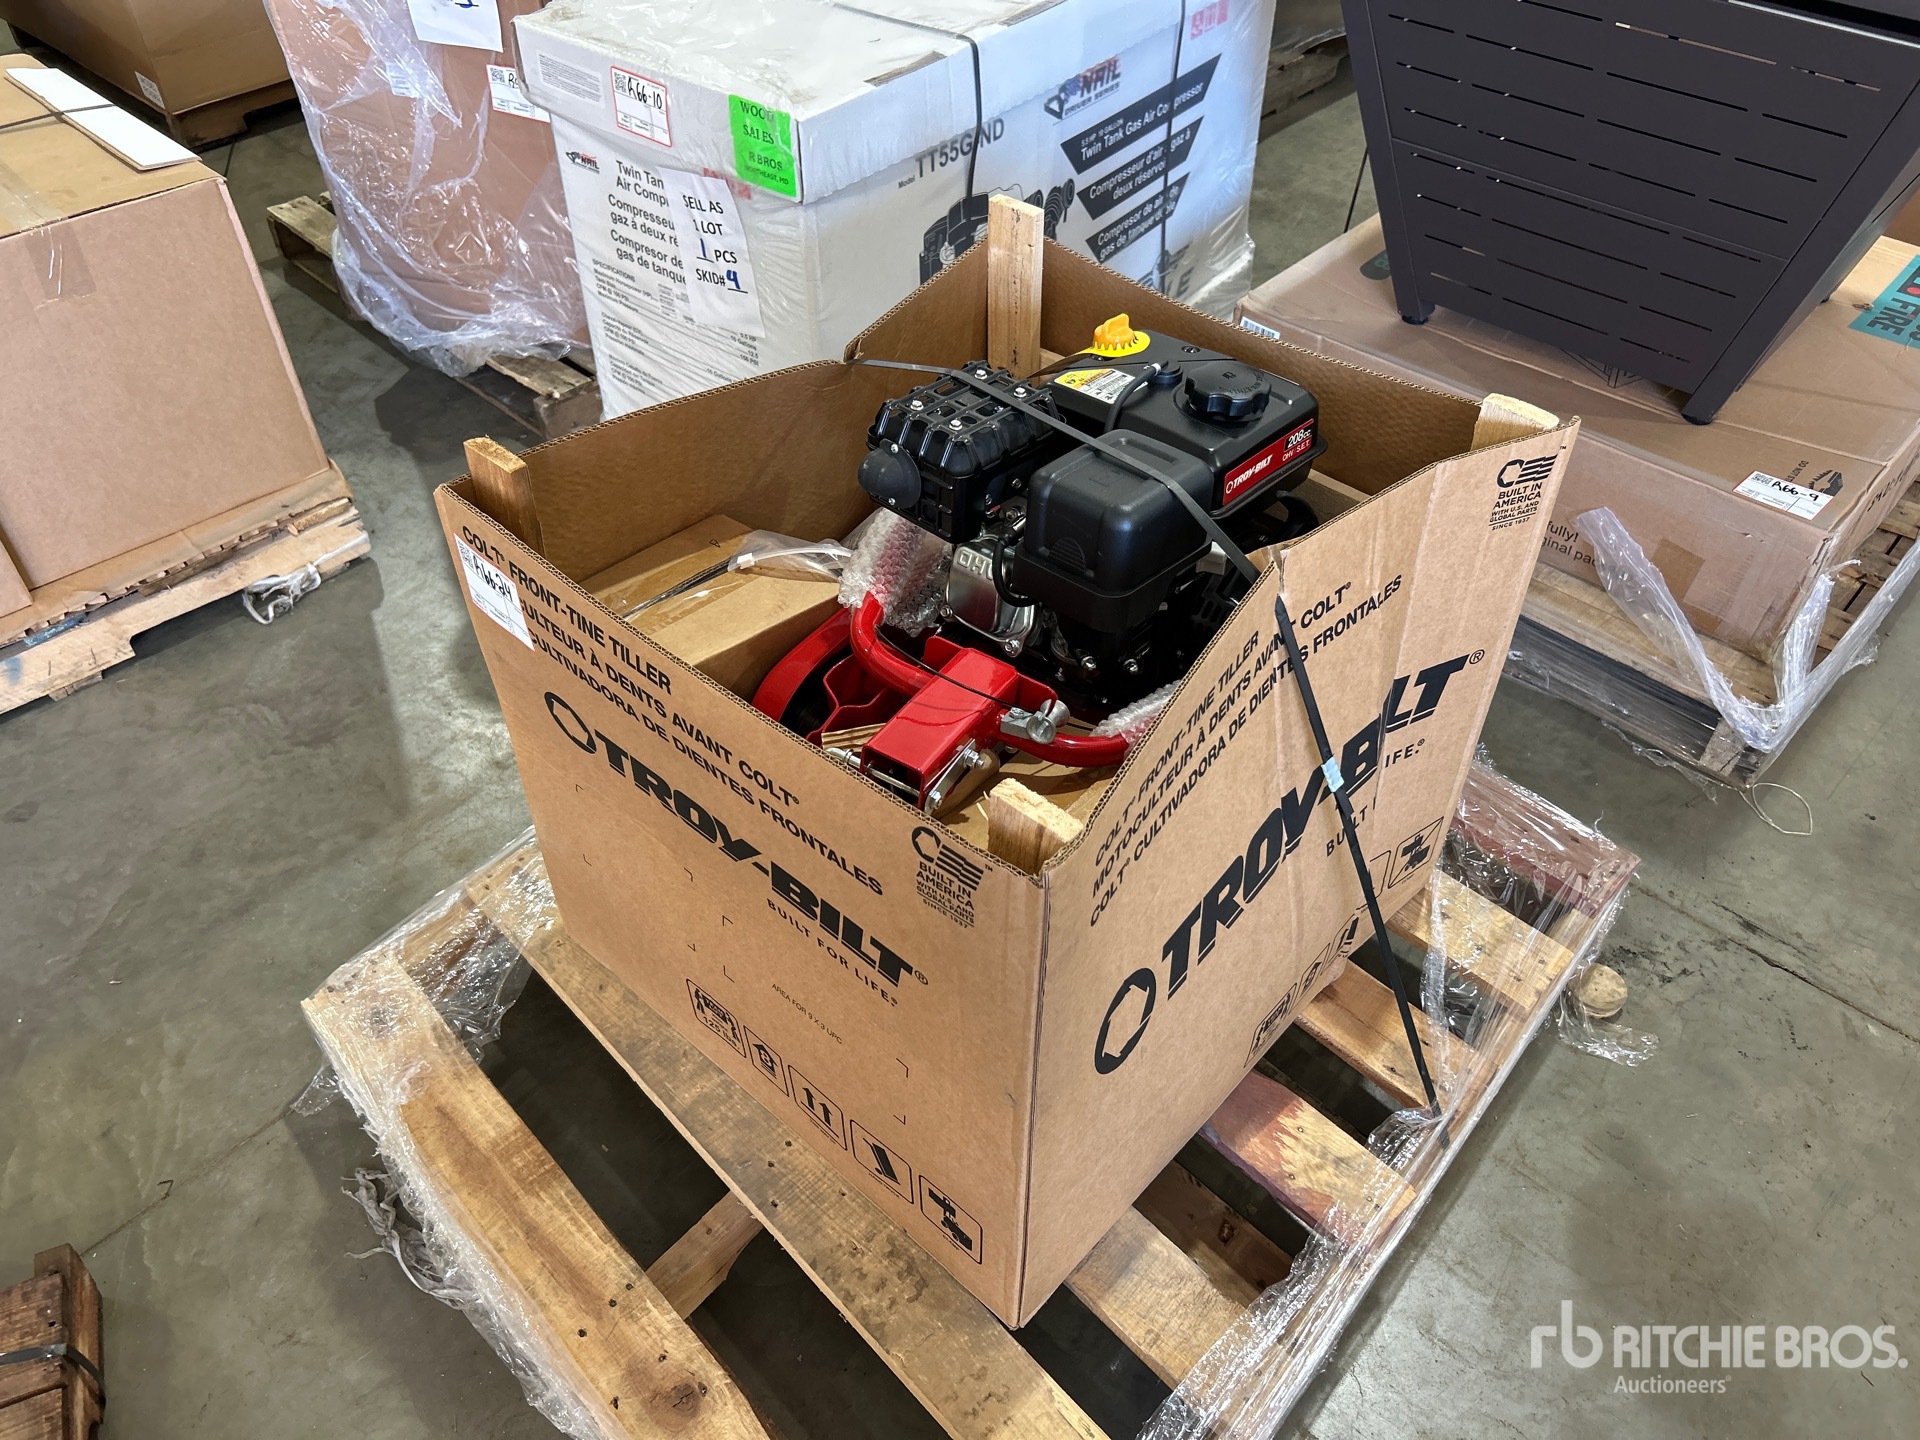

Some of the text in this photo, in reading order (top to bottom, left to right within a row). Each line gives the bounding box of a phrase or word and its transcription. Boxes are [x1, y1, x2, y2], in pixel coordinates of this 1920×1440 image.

[1081, 82, 1204, 161] Twin Tank Gas Air Copressor
[757, 154, 783, 171] BROS
[898, 118, 1004, 189] Model TT55GND
[1089, 158, 1145, 199] Compresseur
[1170, 133, 1185, 152] gaz
[616, 160, 664, 189] Twin Tan
[1113, 157, 1166, 200] deux réservoi
[616, 176, 669, 207] Air Comp
[683, 194, 724, 214] SELL AS
[608, 194, 675, 230] Compresseu
[610, 211, 629, 225] gaz
[631, 217, 638, 230] à
[640, 224, 666, 242] deux
[693, 219, 722, 236] 1 LOT
[1097, 209, 1142, 246] Compresor
[1143, 202, 1153, 216] de
[610, 229, 684, 269] Compresor de
[616, 247, 635, 262] gas
[637, 255, 649, 270] de
[700, 238, 707, 258] 1
[714, 249, 737, 264] PCS
[1100, 243, 1115, 261] gas
[1116, 233, 1127, 248] de
[696, 268, 726, 287] SKID#
[726, 269, 741, 290] 4
[1866, 297, 1920, 336] FIRE
[1232, 453, 1274, 489] TROY-BILT
[1282, 449, 1294, 462] OHV
[1493, 491, 1541, 510] AMERICA
[1498, 482, 1542, 499] BUILT IN
[1490, 507, 1537, 522] GLOBAL PARTS
[1491, 509, 1508, 517] WITH
[1523, 501, 1539, 509] AND
[1492, 522, 1512, 531] SINCE
[1546, 521, 1579, 543] fully!
[1541, 537, 1571, 556] ginal
[509, 560, 605, 647] FRONT-TINE
[609, 635, 671, 695] TILLER
[590, 650, 602, 672] À
[606, 665, 666, 718] DENTS
[672, 712, 732, 765] AVANT
[1134, 735, 1226, 861] CULTIVADORA
[1229, 707, 1247, 741] DE
[1313, 574, 1402, 654] FRONTALES
[1138, 686, 1216, 802] FRONT-TINE
[1218, 630, 1259, 693] TILLER
[1093, 744, 1193, 898] MOTOCULTEUR
[1196, 726, 1206, 752] À
[1208, 669, 1251, 734] DENTS
[642, 713, 669, 743] DE
[673, 738, 754, 805] DIENTES
[761, 804, 883, 896] FRONTALES
[1326, 805, 1367, 857] BULT
[916, 870, 974, 910] AMERICA
[920, 861, 971, 899] BUILT IN
[917, 879, 937, 895] WITH
[957, 903, 974, 917] AND
[917, 886, 974, 924] GLOBAL PARTS
[923, 899, 947, 916] SINCE
[767, 898, 811, 938] BUILT
[817, 937, 849, 969] FOR
[703, 1016, 721, 1032] 125
[772, 983, 791, 1003] AREA
[792, 999, 807, 1016] FOR
[826, 1027, 842, 1045] UPC
